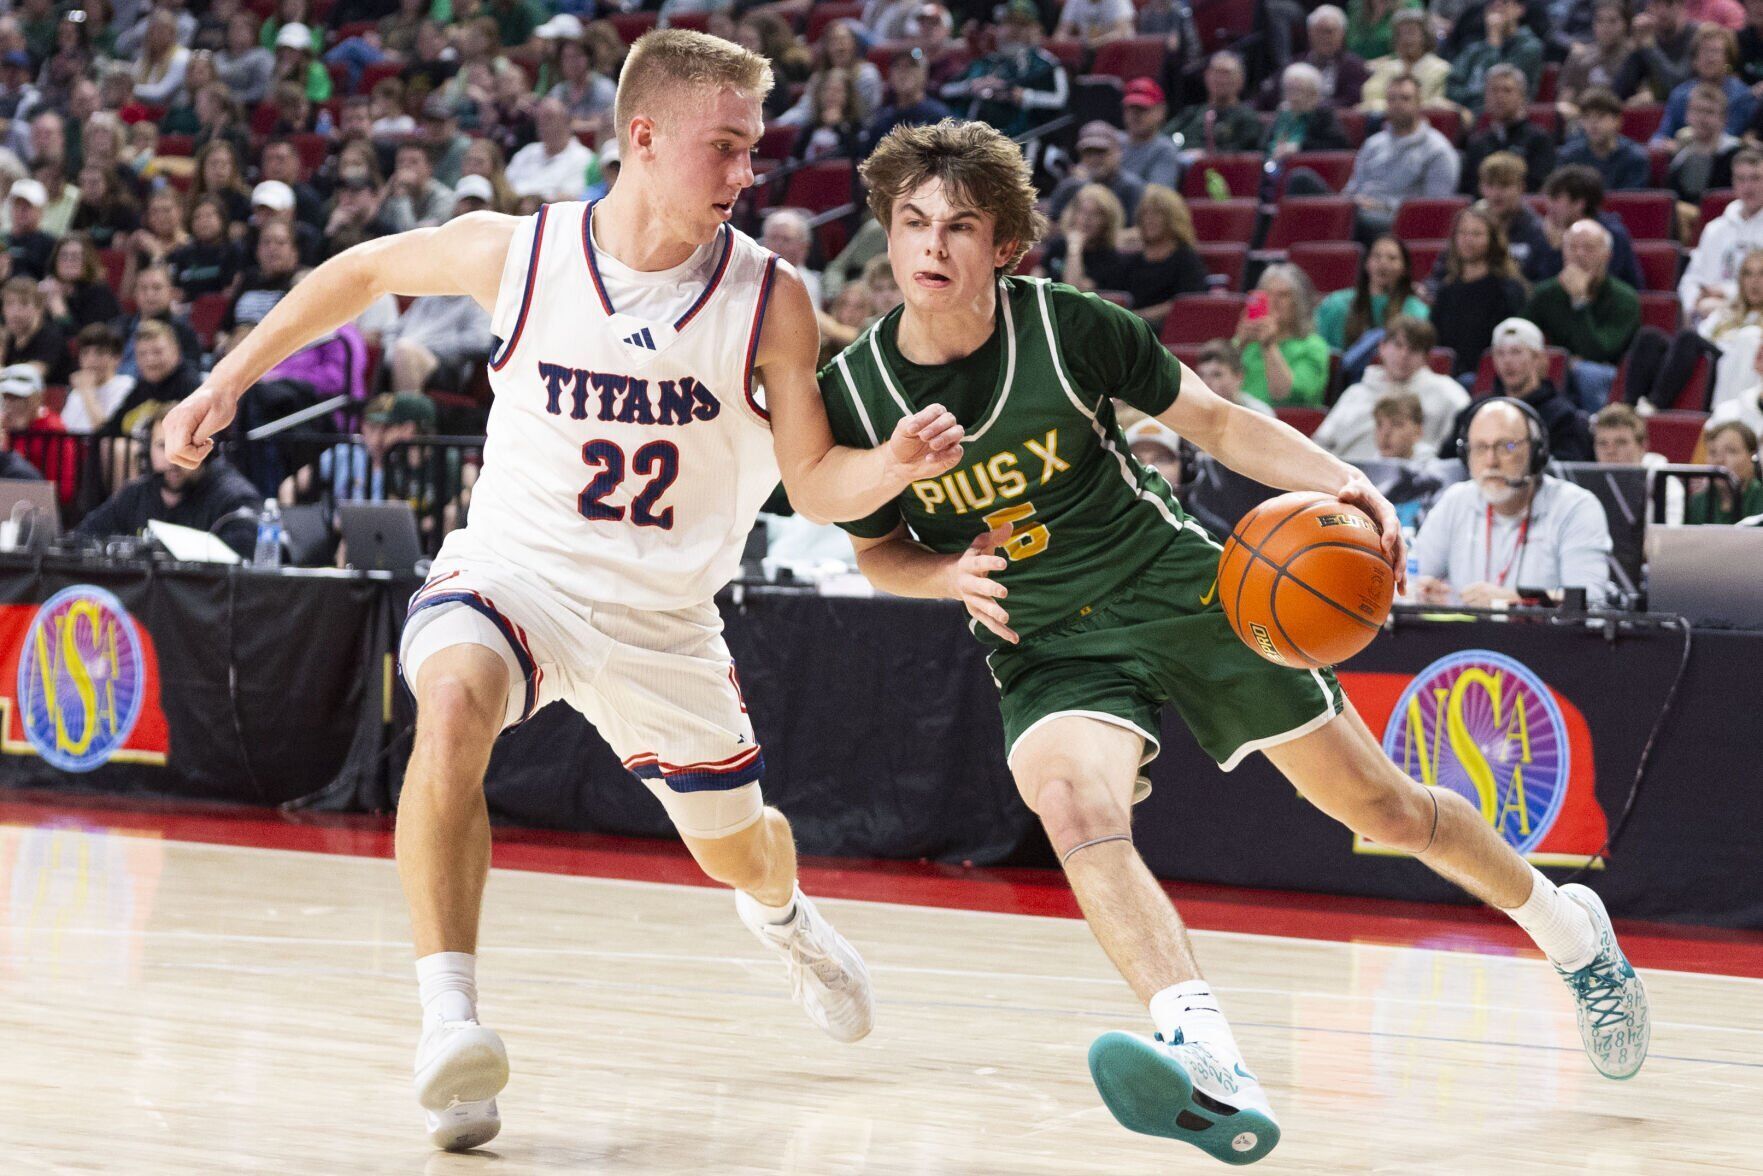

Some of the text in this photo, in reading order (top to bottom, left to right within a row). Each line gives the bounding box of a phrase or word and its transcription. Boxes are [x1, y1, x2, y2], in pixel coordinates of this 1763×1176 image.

[538, 360, 721, 426] TITANS
[577, 438, 680, 531] 22
[911, 428, 1071, 515] PIUS X
